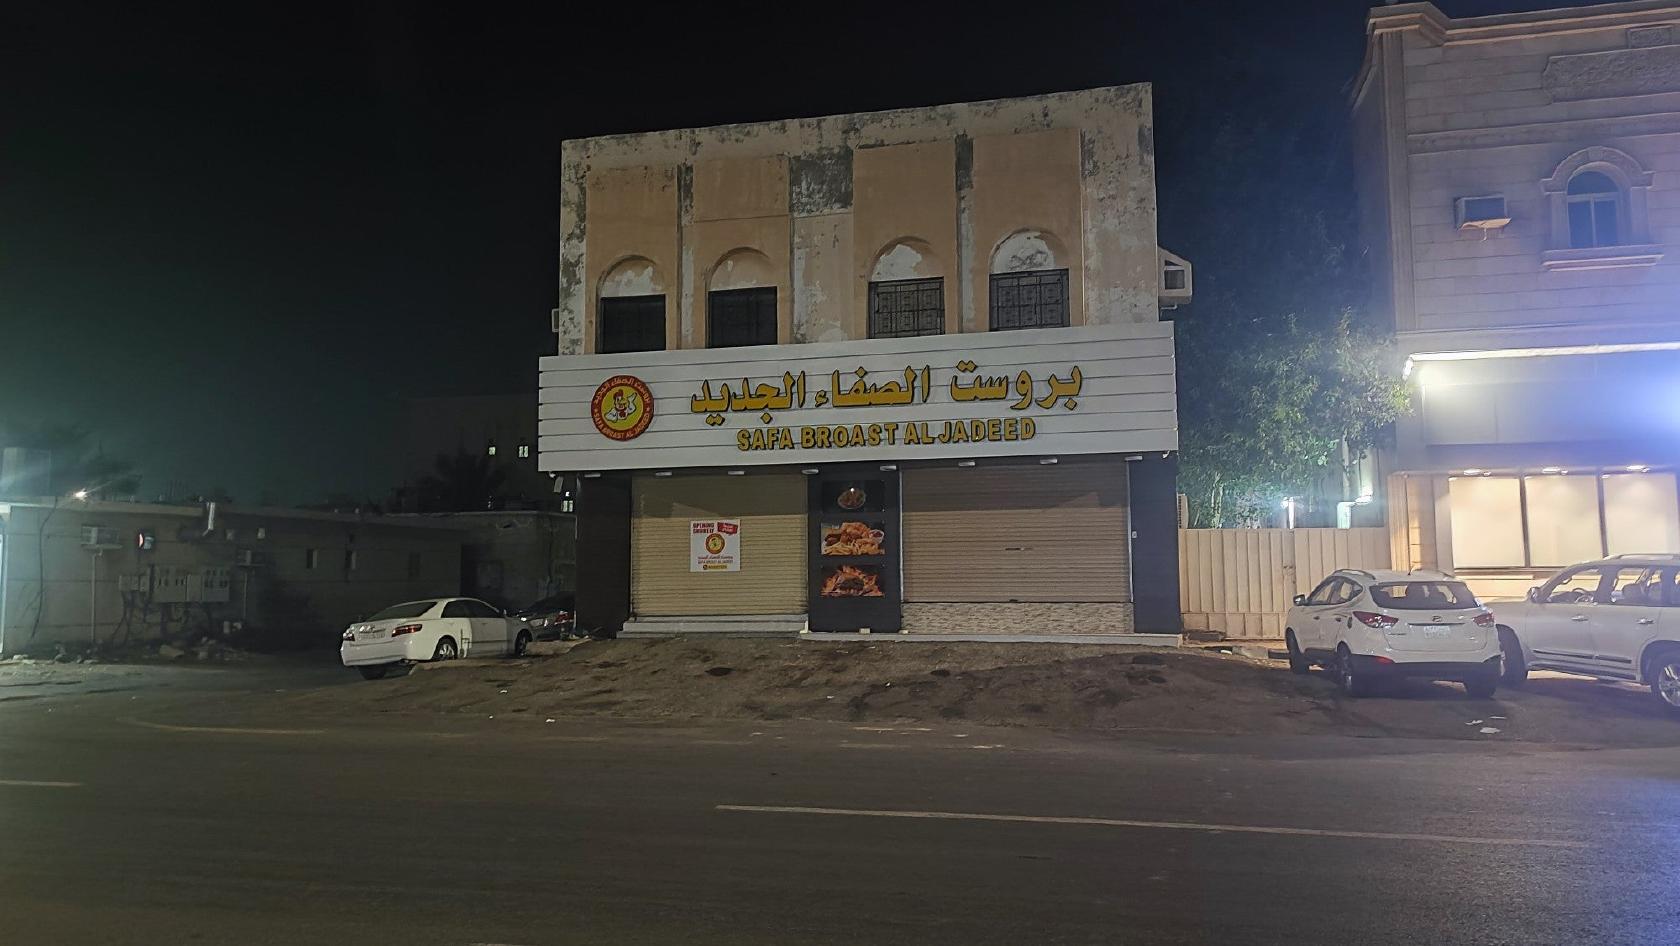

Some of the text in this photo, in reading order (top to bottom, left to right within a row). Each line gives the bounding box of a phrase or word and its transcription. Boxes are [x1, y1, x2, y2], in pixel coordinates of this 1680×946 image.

[690, 359, 1083, 427] بروست الصفاء الجديد
[736, 427, 795, 451] SAFA
[800, 422, 899, 449] BROAST
